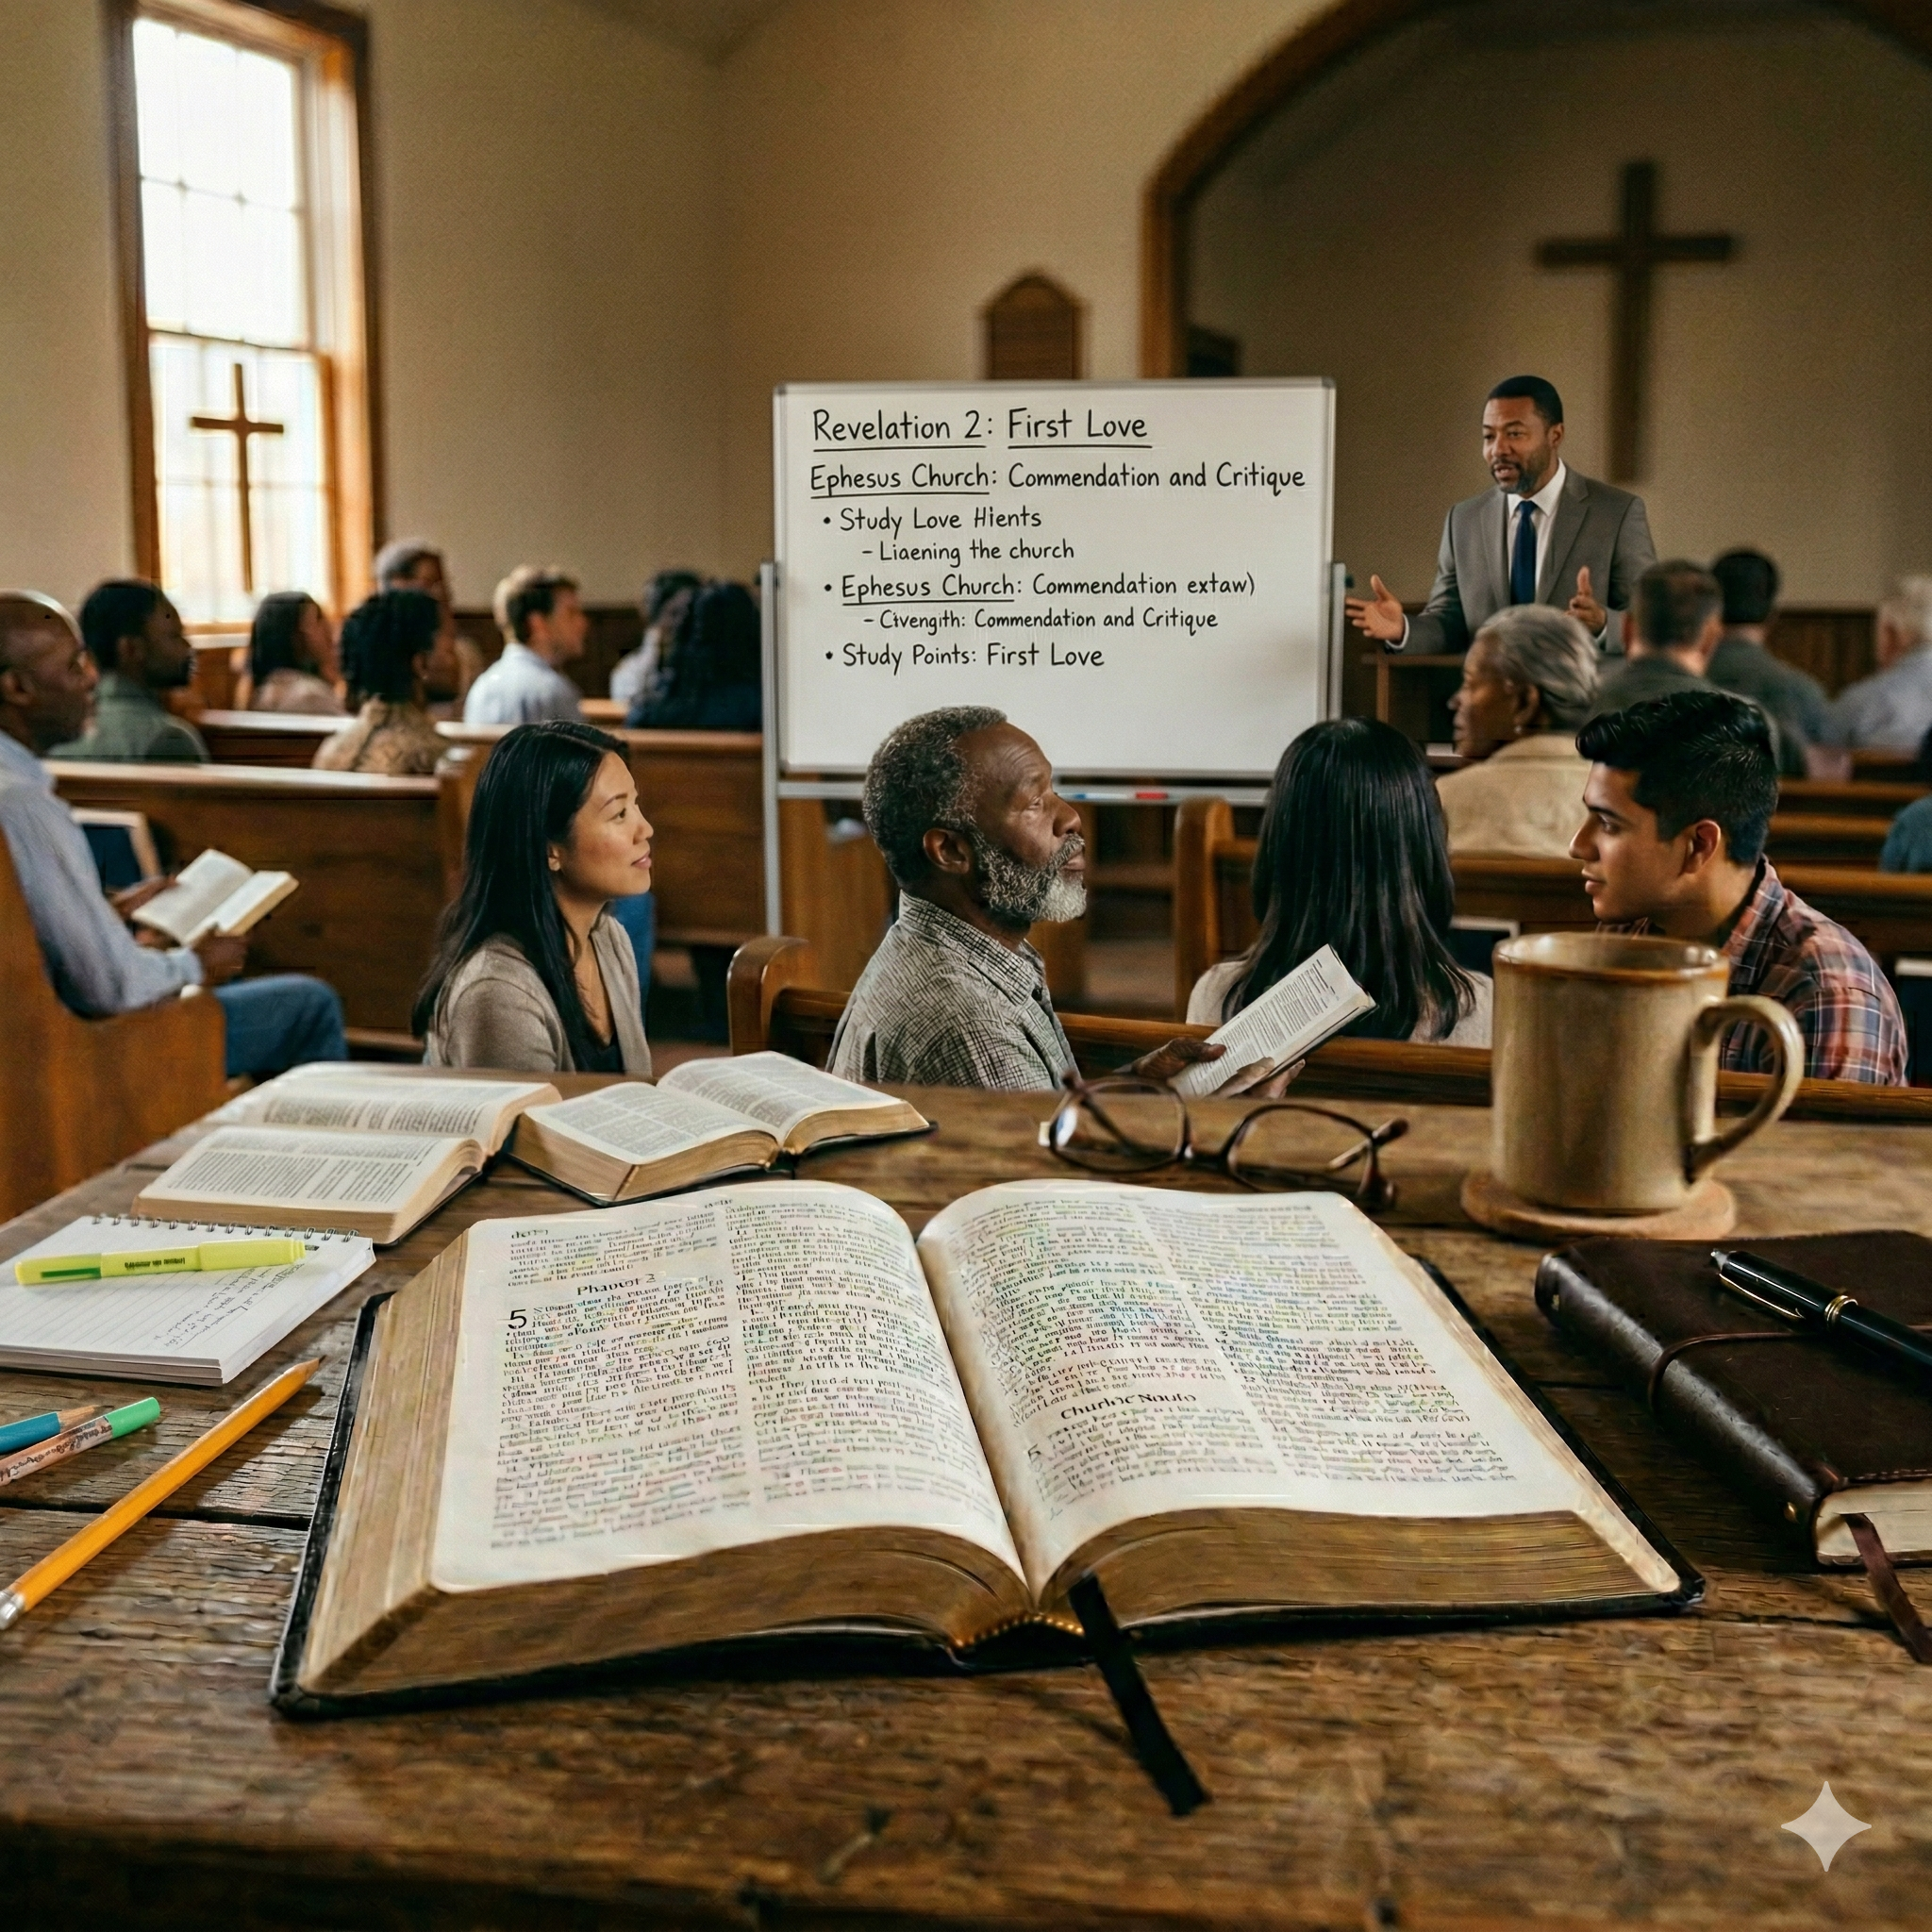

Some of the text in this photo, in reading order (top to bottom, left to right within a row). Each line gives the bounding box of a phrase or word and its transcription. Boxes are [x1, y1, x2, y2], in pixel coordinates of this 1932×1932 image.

[813, 408, 1148, 441] Revelation 2: First Love
[810, 461, 1306, 497] Ephesus Church: Commendation and Critique
[840, 505, 1042, 540] Study Love Hients
[880, 537, 1074, 569] Liaening the church
[841, 572, 1255, 602] Ephesus Church: Commendation extaw)
[974, 607, 1096, 628] Commendation
[1103, 606, 1135, 627] and
[1142, 607, 1219, 637] Critique
[842, 641, 1105, 675] Study Points: First Love
[508, 1308, 528, 1330] 5
